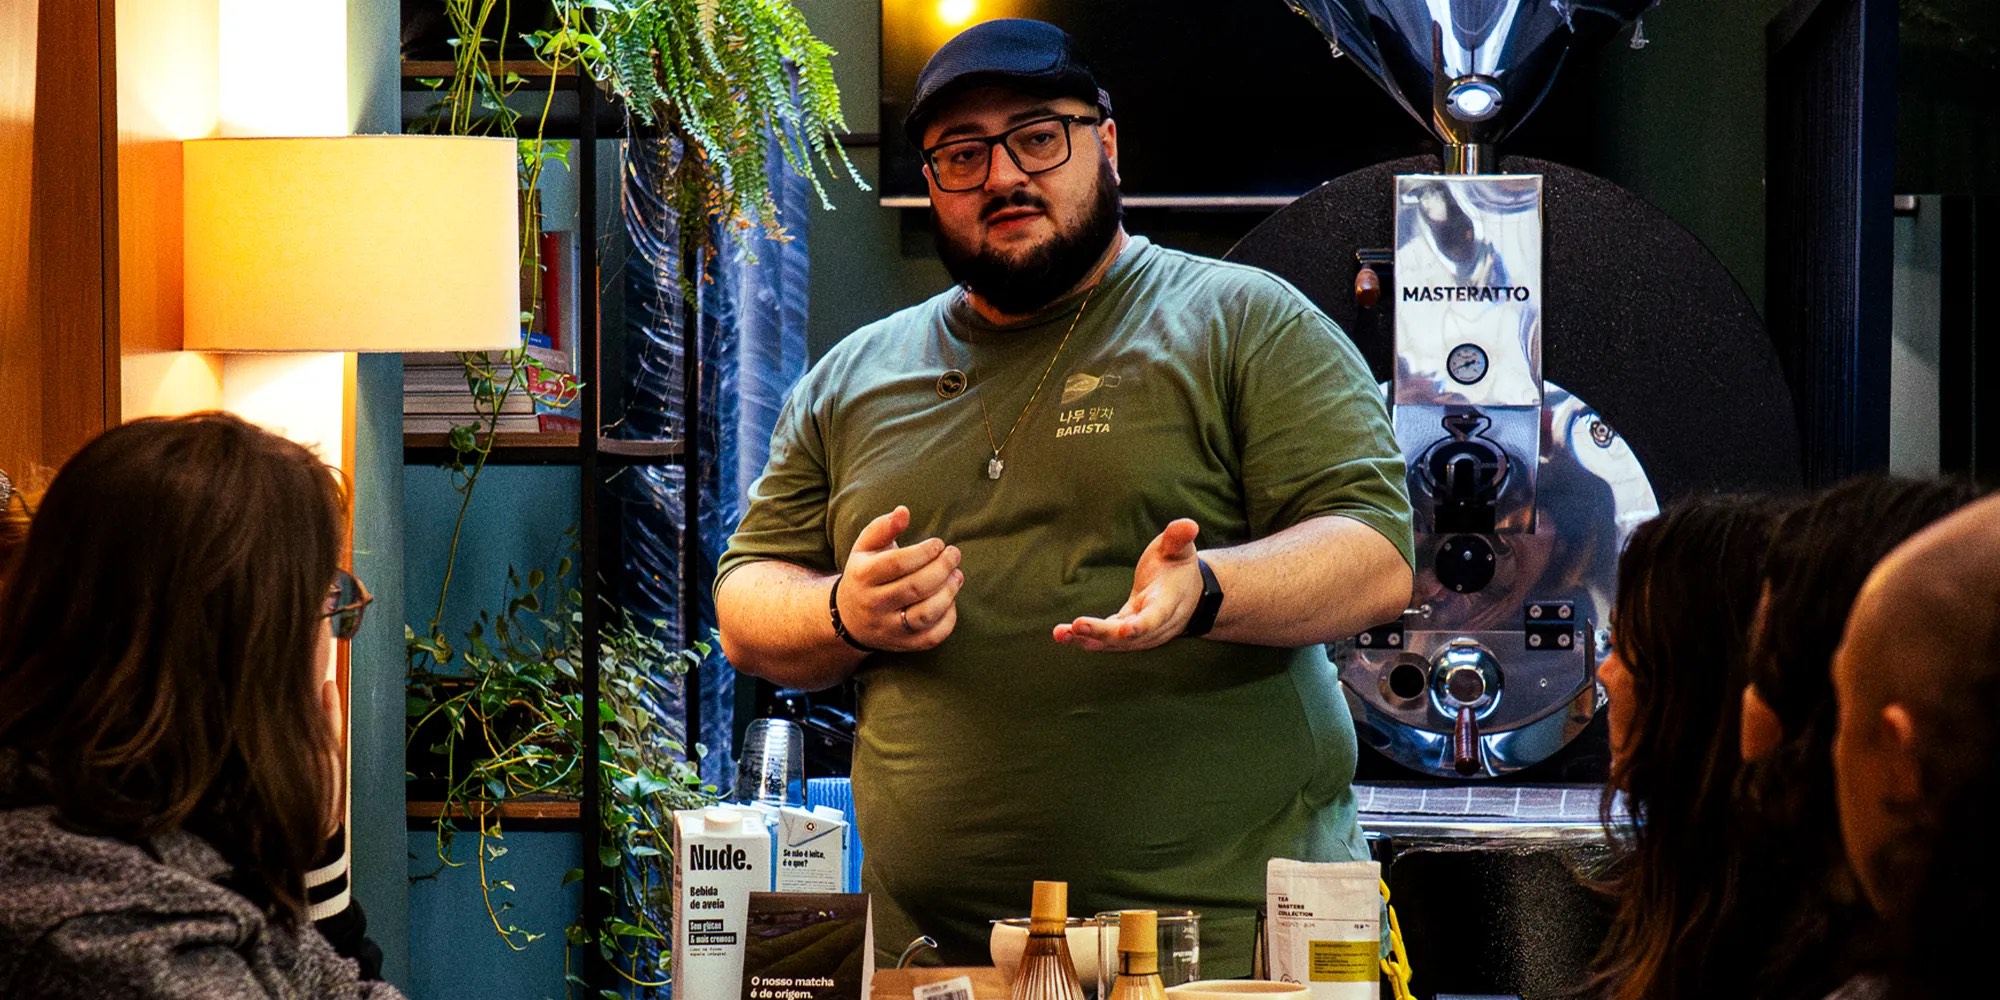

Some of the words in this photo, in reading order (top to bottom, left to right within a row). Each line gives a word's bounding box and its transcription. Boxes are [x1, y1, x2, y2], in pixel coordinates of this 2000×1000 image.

[1403, 286, 1530, 302] MASTERATTO
[1060, 409, 1085, 424] 나무
[1055, 423, 1110, 438] BARISTA
[690, 844, 753, 870] Nude.
[783, 849, 791, 857] Se
[804, 850, 808, 858] é
[809, 850, 825, 859] leite,
[782, 859, 787, 867] é
[793, 859, 808, 868] que?
[690, 886, 718, 897] Bebida
[690, 900, 700, 910] de
[702, 899, 725, 910] aveia
[751, 976, 760, 986] O
[762, 978, 793, 986] nosso
[795, 976, 834, 987] matcha
[750, 988, 757, 998] é
[759, 988, 773, 998] de
[774, 988, 813, 1000] origem.
